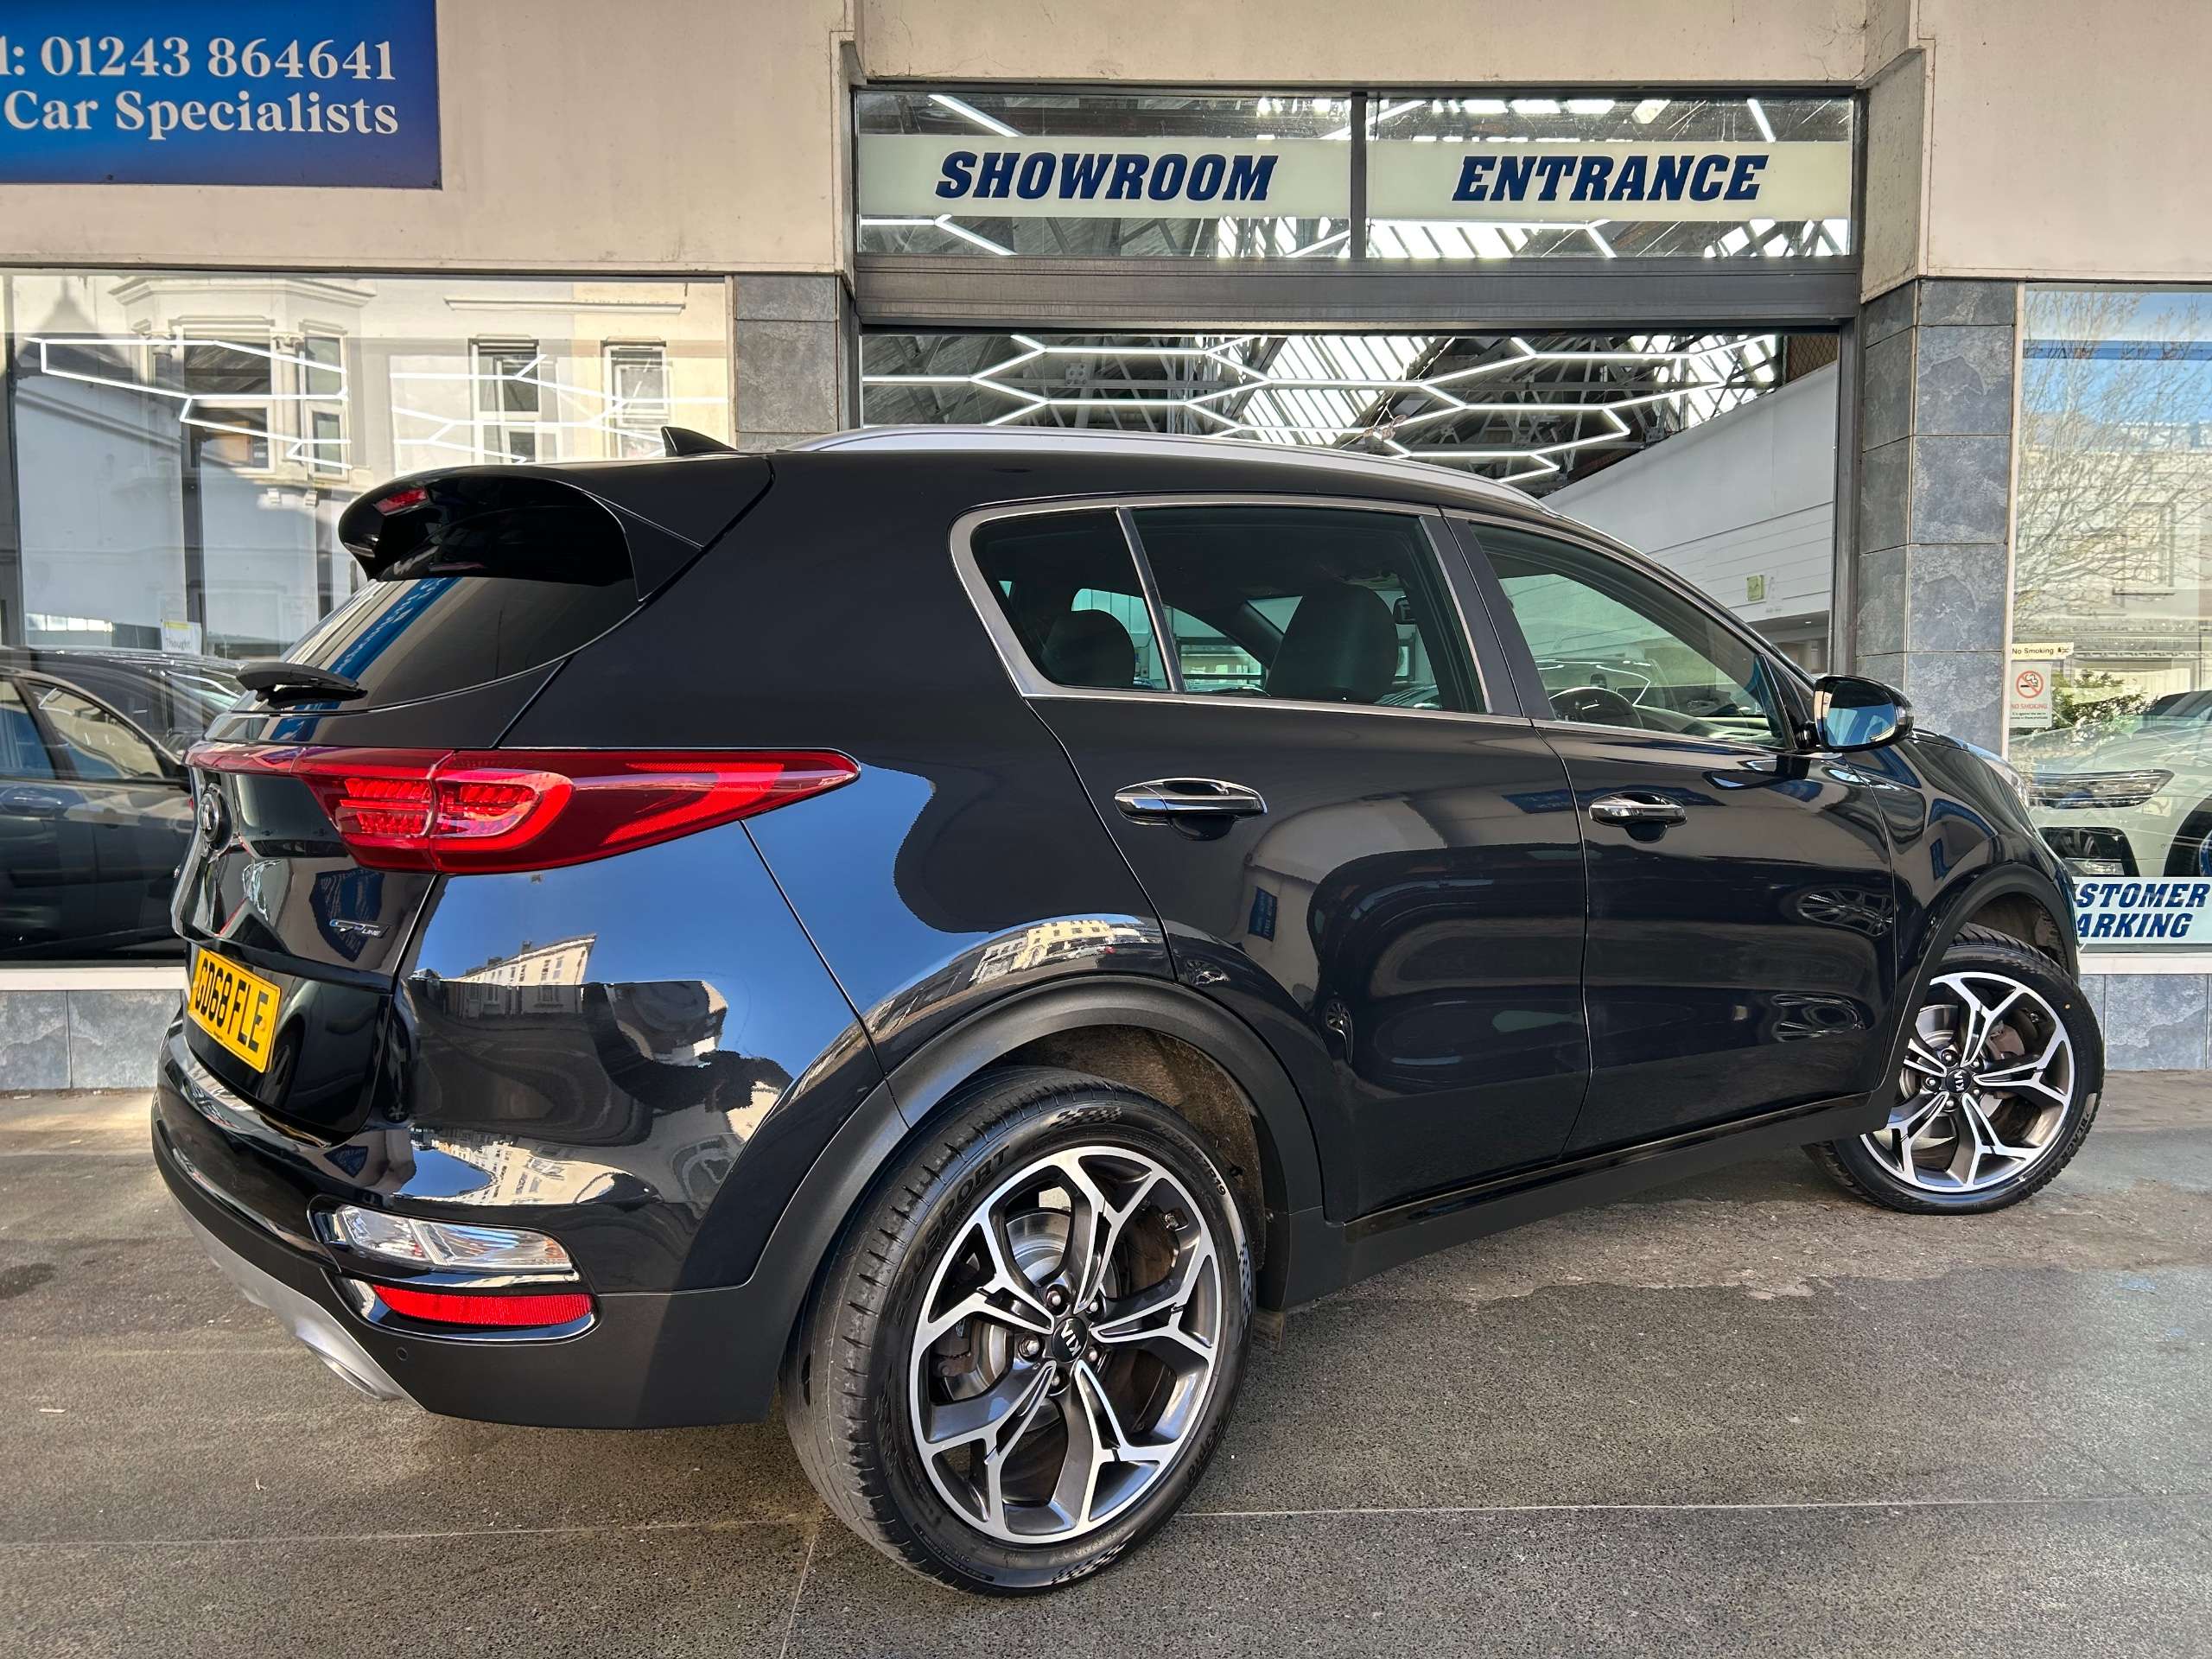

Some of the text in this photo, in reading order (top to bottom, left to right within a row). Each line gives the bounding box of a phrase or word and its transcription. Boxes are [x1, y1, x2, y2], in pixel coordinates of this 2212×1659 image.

[41, 35, 190, 77] 01243
[207, 38, 397, 80] 864641
[3, 90, 399, 141] Car Specialists
[935, 151, 1770, 201] SHOWROOM ENTRANCE
[2024, 647, 2055, 656] Smoking
[2075, 882, 2210, 908] STOMER
[2076, 912, 2194, 938] ARKING
[227, 978, 270, 1052] FLE
[1954, 1069, 1965, 1092] KIA
[1060, 1318, 1082, 1357] KIA
